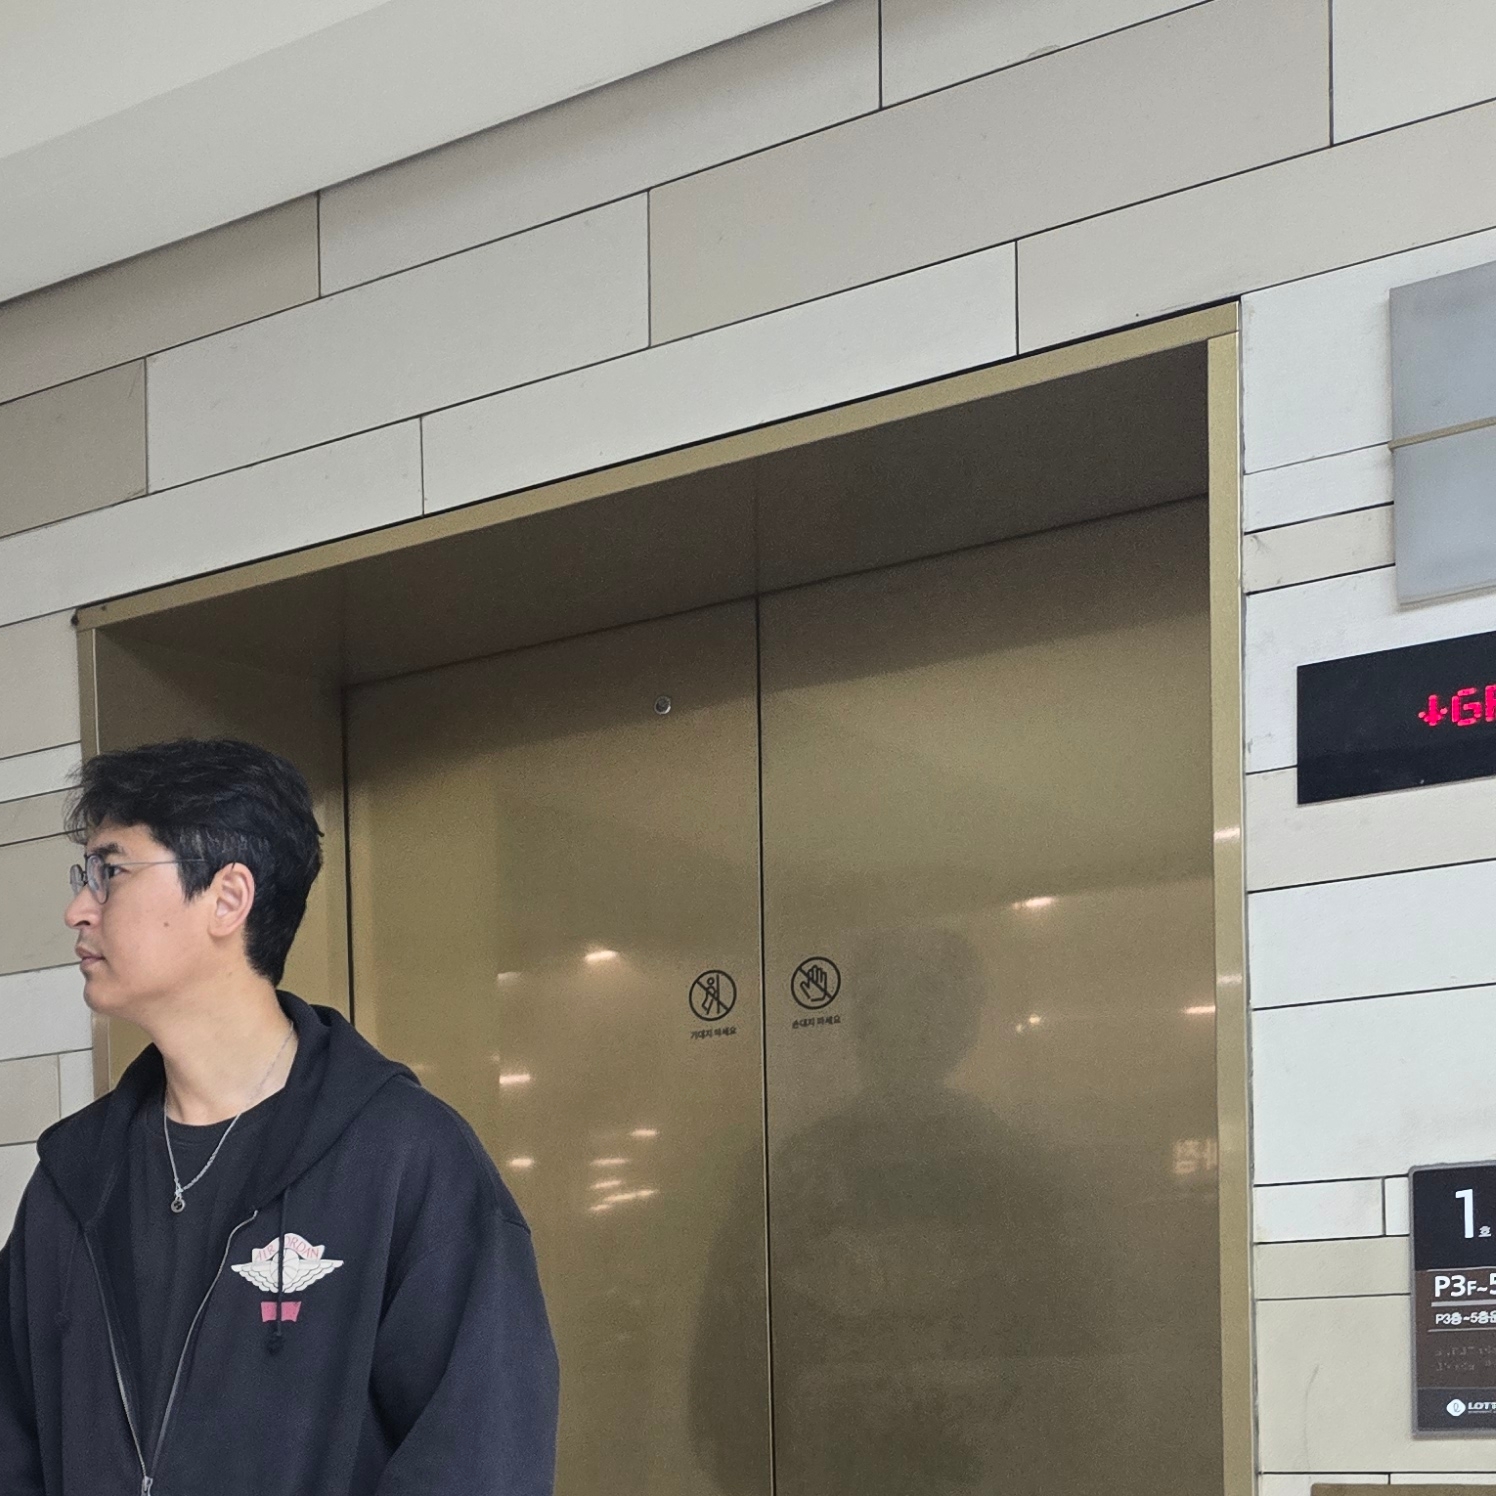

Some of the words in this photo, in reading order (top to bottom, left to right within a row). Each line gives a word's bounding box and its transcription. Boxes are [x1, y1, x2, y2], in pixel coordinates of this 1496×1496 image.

[817, 1014, 842, 1026] 마세요
[255, 1243, 276, 1260] AIR
[285, 1235, 320, 1259] ORDAN
